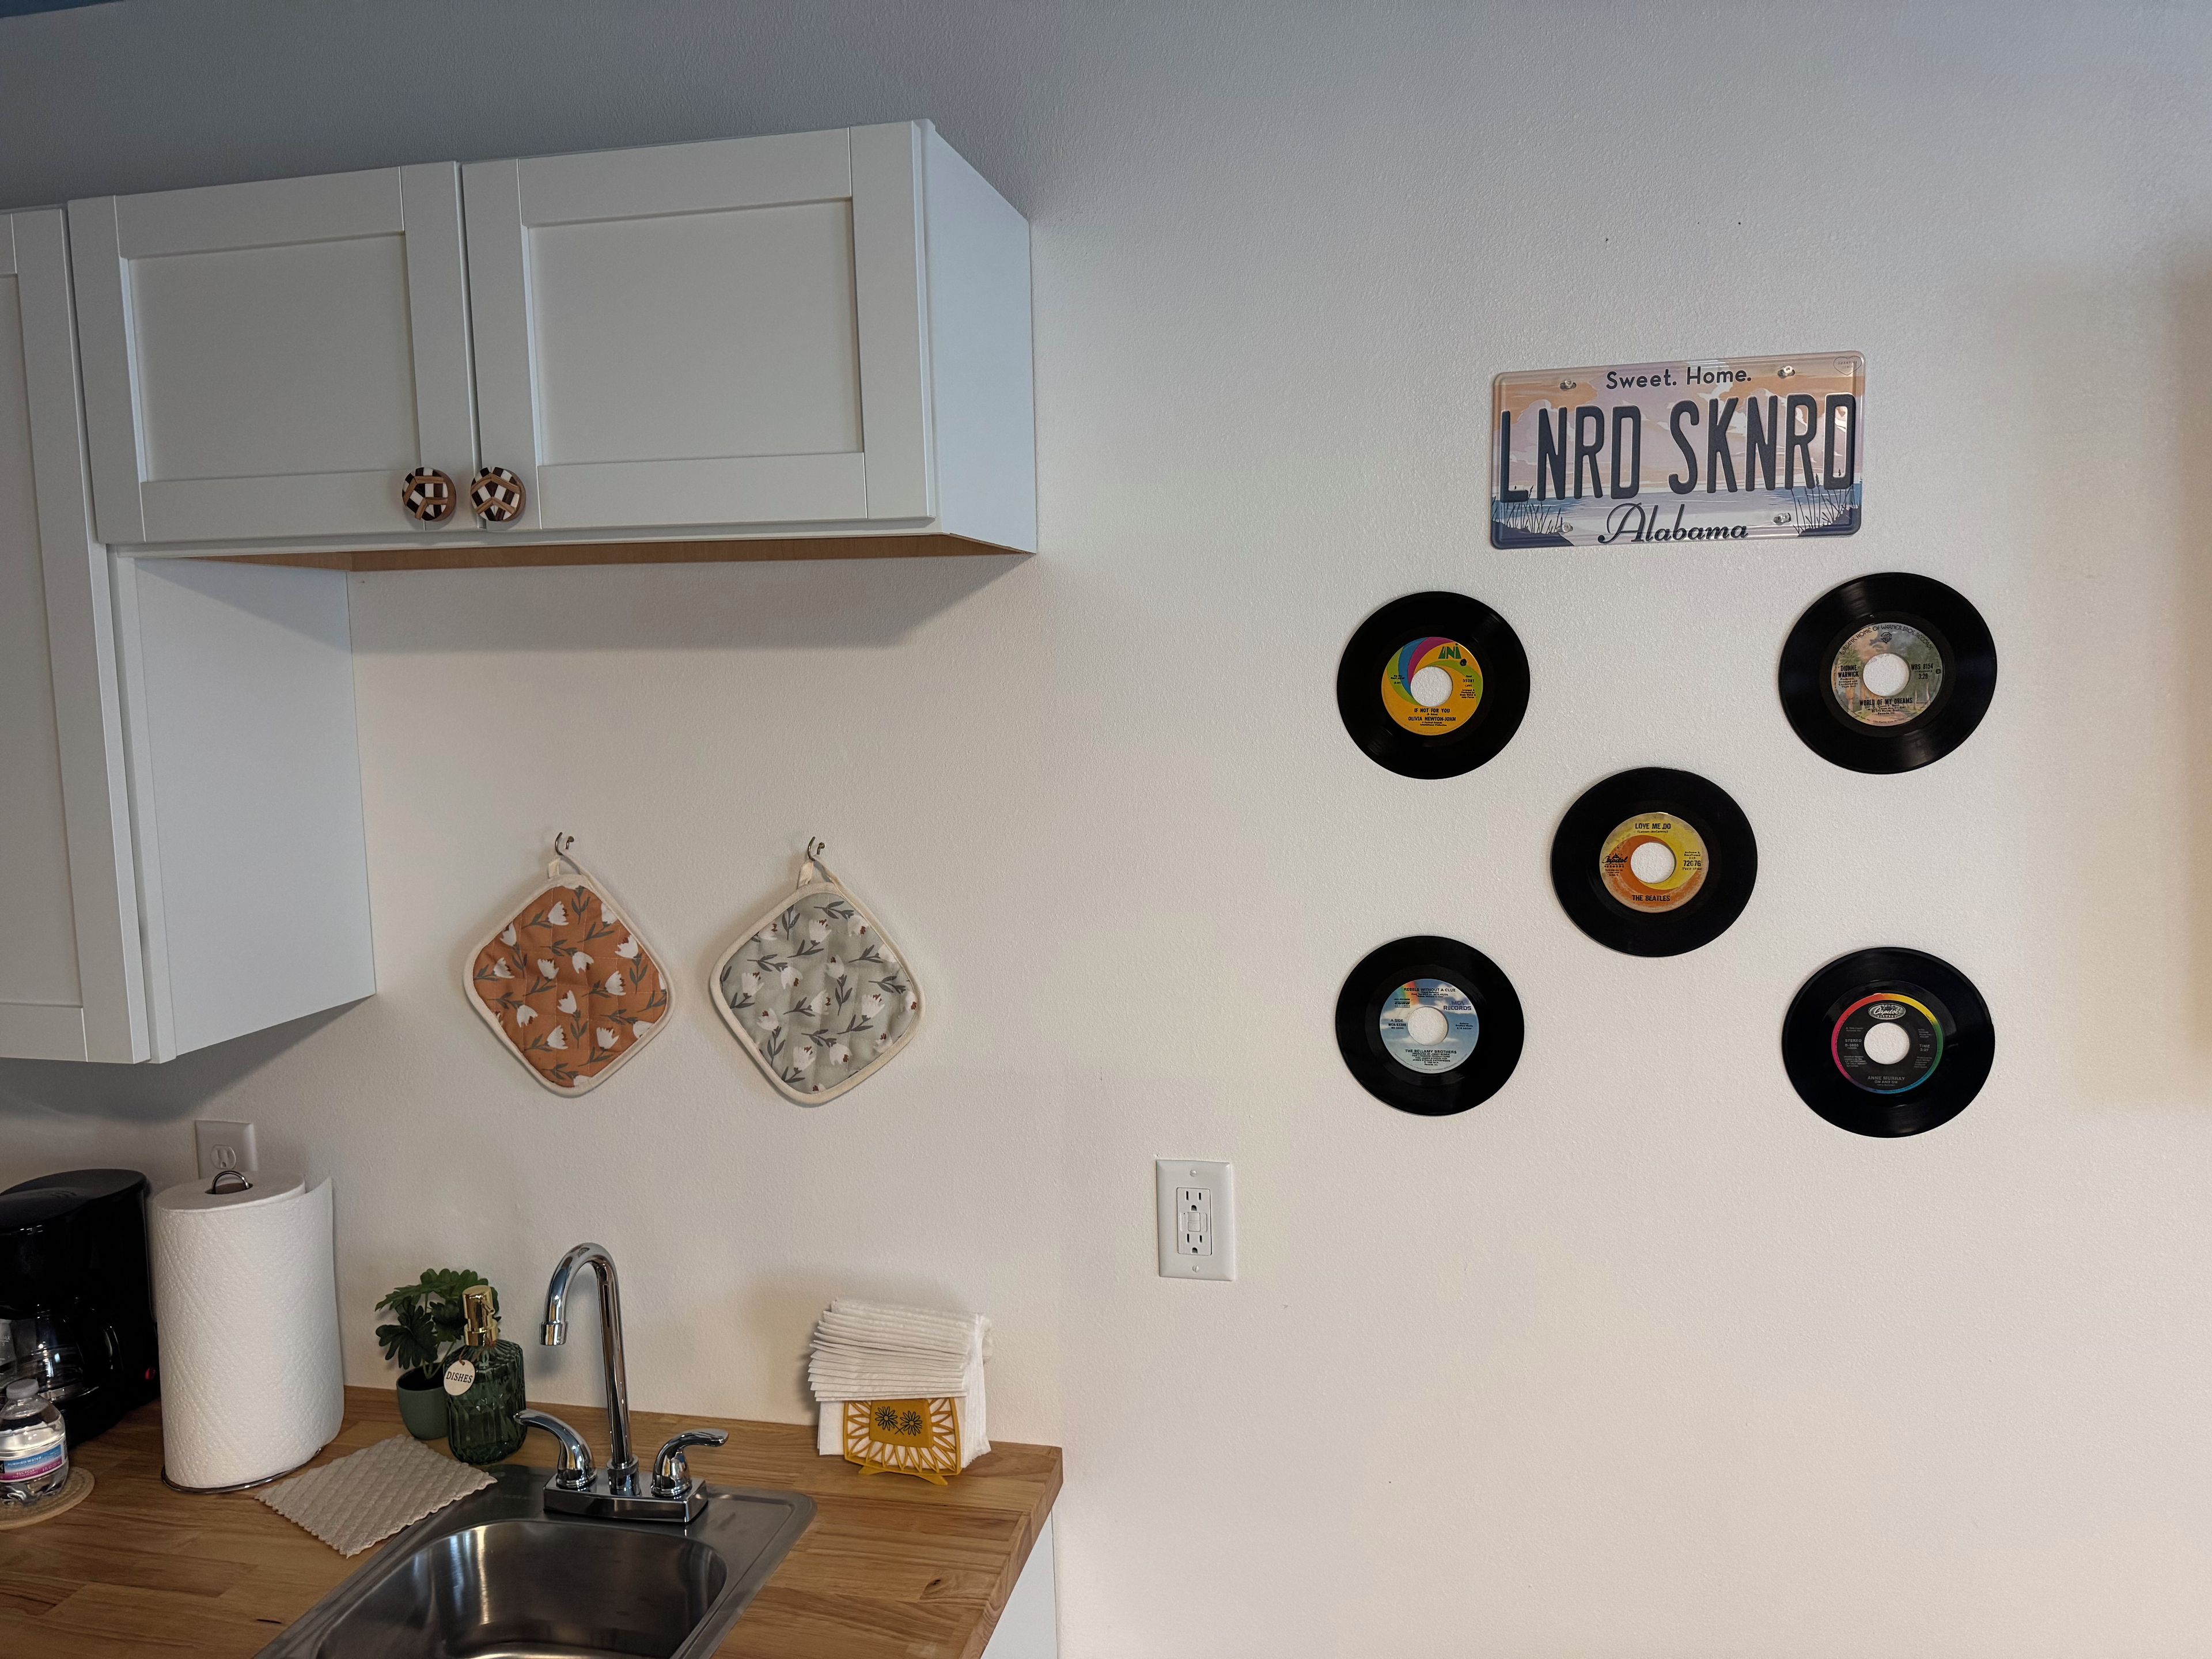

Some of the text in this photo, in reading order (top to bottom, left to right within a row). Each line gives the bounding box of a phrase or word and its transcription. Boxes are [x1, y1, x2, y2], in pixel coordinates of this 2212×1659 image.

[1606, 366, 1752, 389] Sweet. Home.
[1500, 393, 1857, 503] LNRD SKNRD
[1597, 502, 1749, 544] Alabama
[1857, 628, 1872, 638] HOME
[1602, 855, 1628, 865] Capitol
[1874, 1007, 1899, 1015] Capitol
[446, 1371, 473, 1383] DISHES
